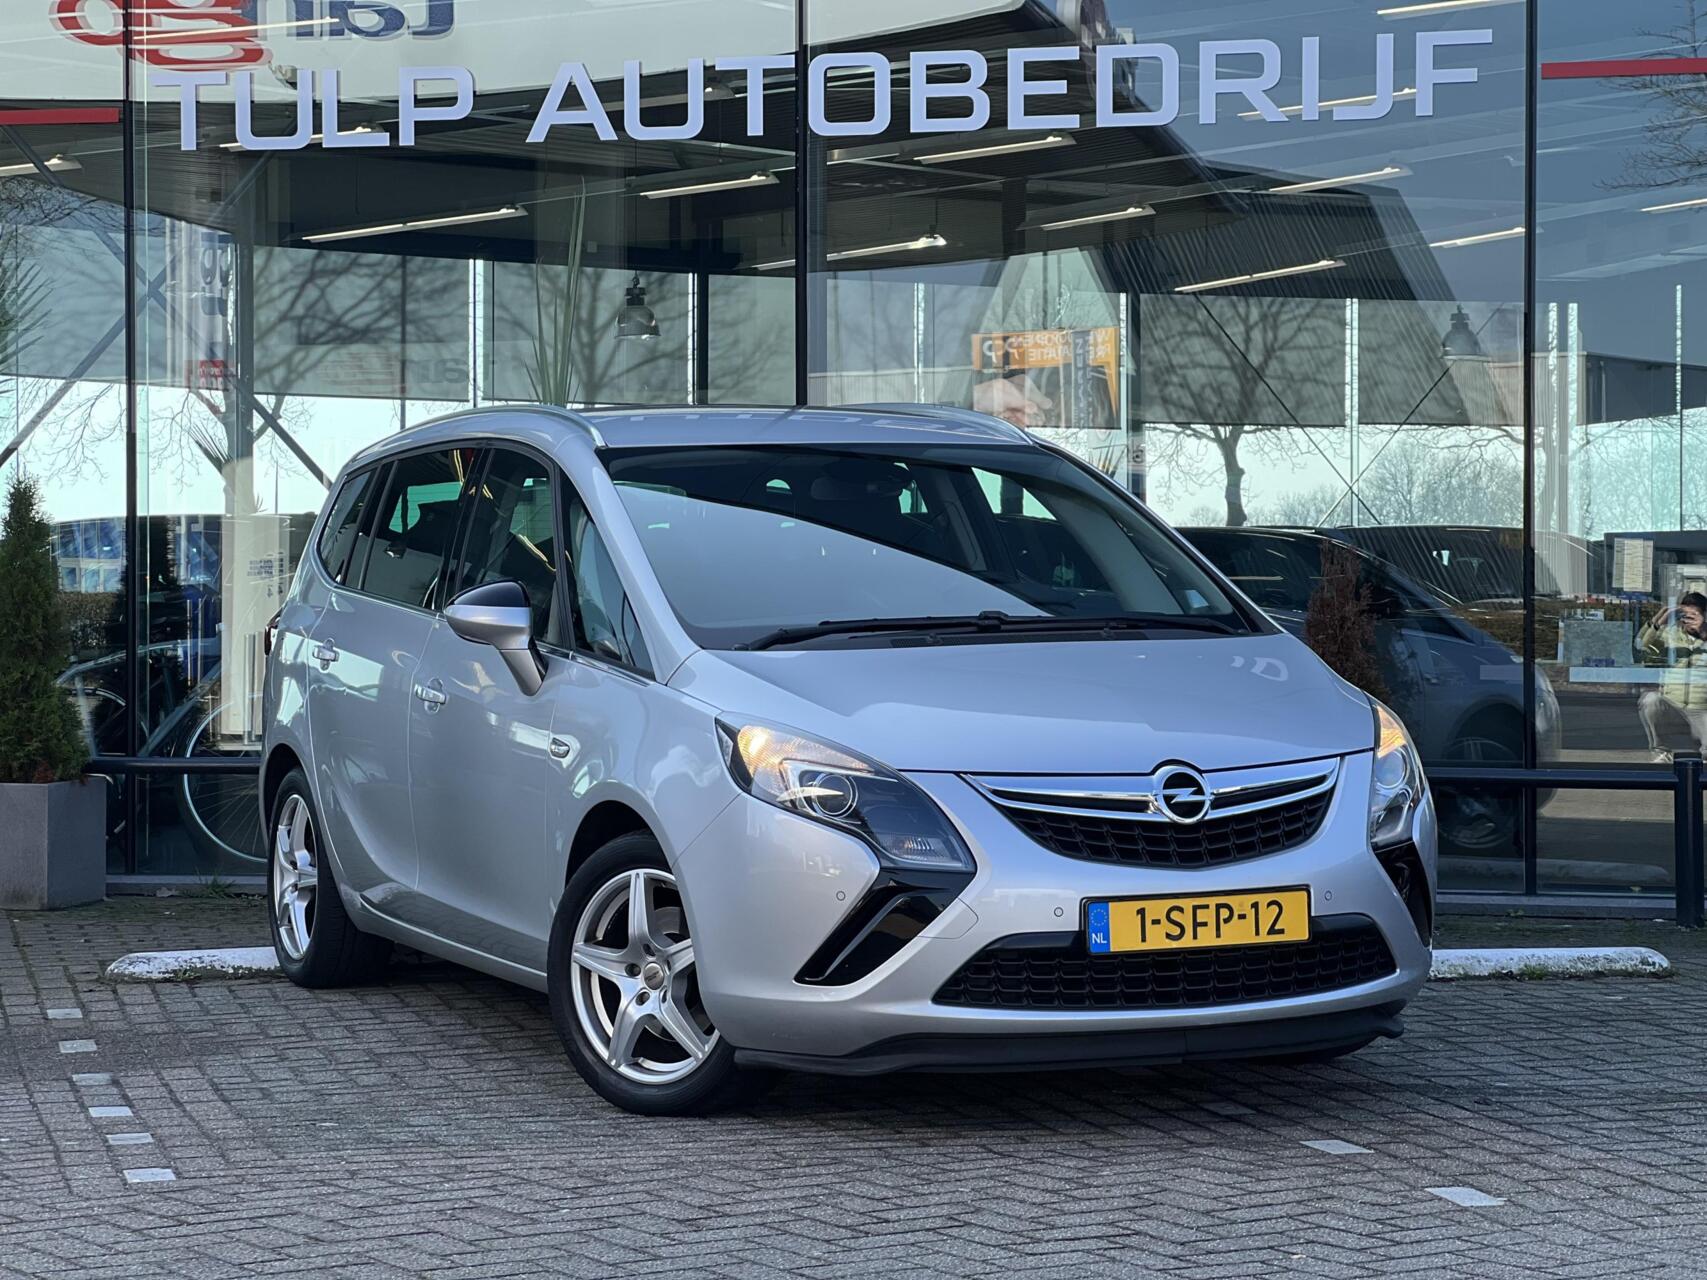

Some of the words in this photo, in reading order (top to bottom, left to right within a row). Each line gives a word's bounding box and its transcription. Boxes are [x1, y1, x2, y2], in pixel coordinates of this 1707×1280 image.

[152, 66, 475, 151] TULP
[526, 29, 1493, 143] AUTOBEDRIJF
[1092, 932, 1108, 945] NL
[1136, 899, 1285, 943] 1-SFP-12
